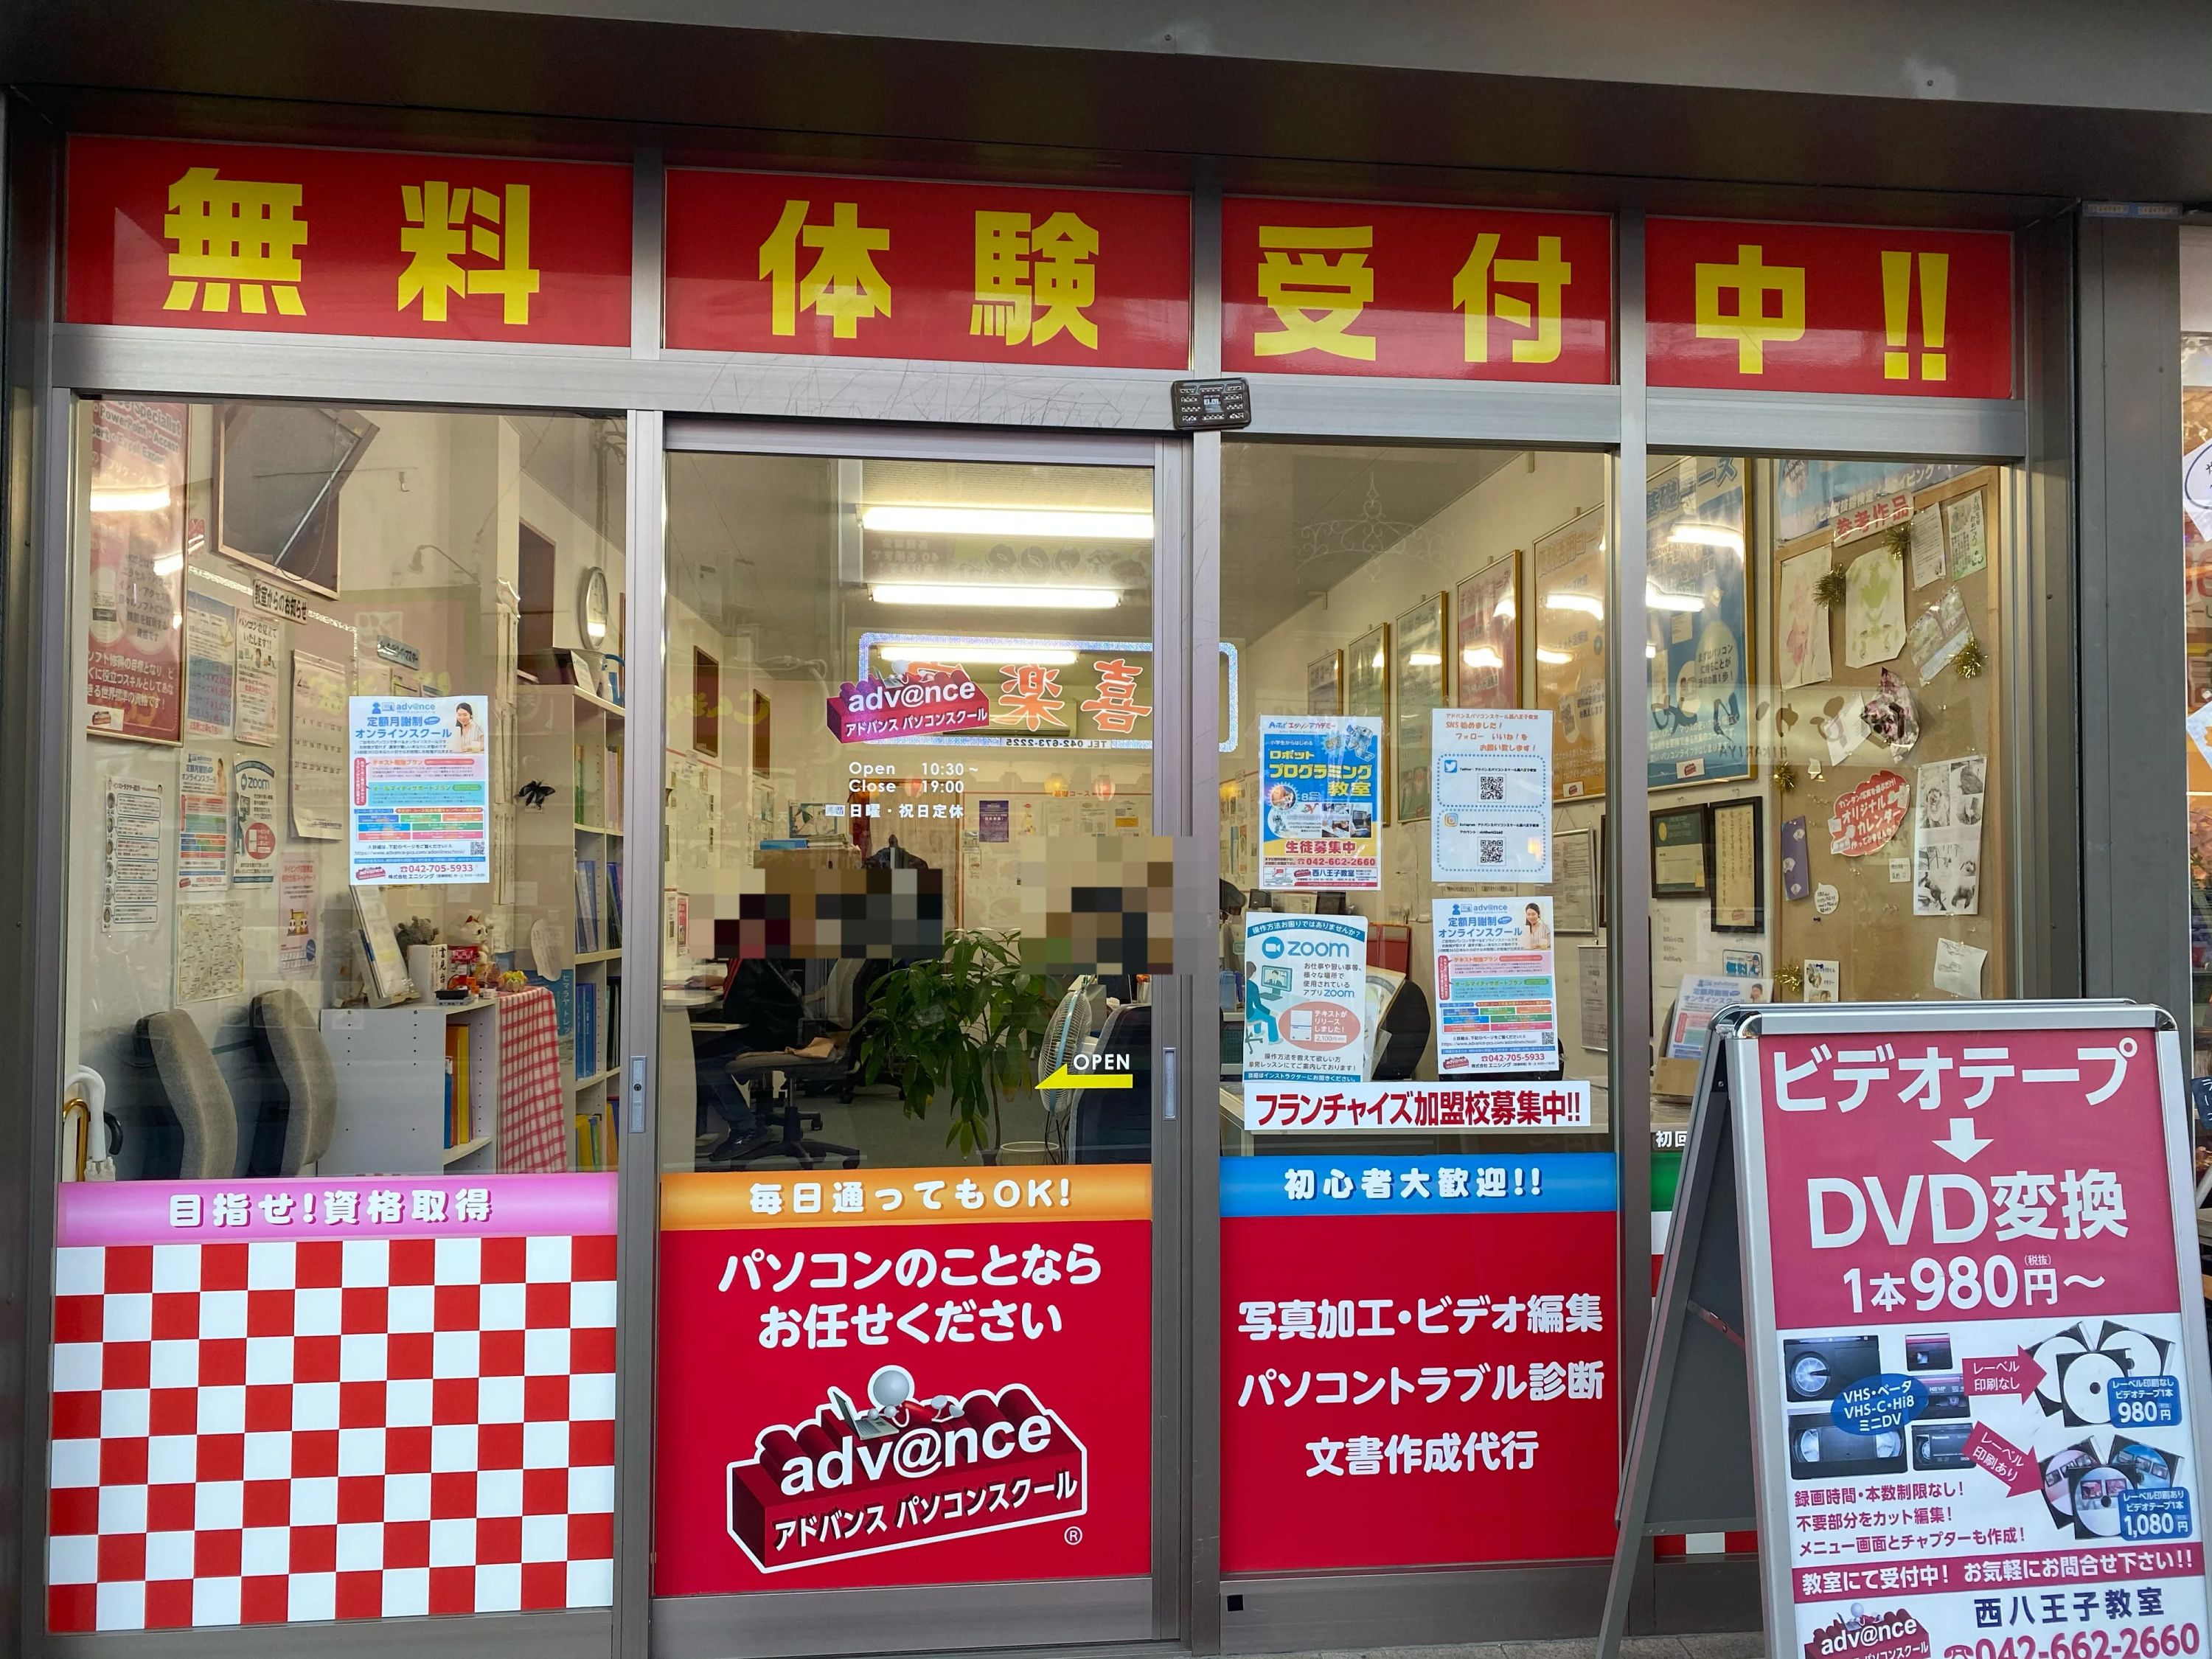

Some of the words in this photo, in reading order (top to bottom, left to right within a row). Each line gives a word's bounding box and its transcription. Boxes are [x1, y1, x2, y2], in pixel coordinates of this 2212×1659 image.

[162, 167, 540, 326] 無料
[758, 199, 1100, 352] 体験
[1253, 225, 1572, 365] 受付
[100, 406, 147, 436] PowerPoint
[134, 402, 182, 436] Specialist
[1836, 494, 1910, 540] 参考作品
[254, 583, 307, 621] 教室からのお知らせ
[848, 681, 975, 712] adv@nce
[355, 728, 452, 739] オンラインスクール
[367, 717, 422, 727] 定額月謝制
[846, 719, 899, 737] アドバンス
[902, 708, 988, 731] パソコンスクール
[1269, 749, 1315, 760] ロボット
[849, 761, 895, 777] Open
[922, 762, 964, 775] 10:30
[1269, 763, 1372, 779] プログラミング
[248, 776, 270, 791] zoom
[849, 779, 897, 793] Close
[922, 780, 964, 793] 19:00
[1328, 782, 1372, 797] 教室
[850, 803, 964, 818] 日曜・祝日定休
[1842, 795, 1886, 824] オリジナル
[1857, 808, 1901, 835] カレンダー
[1285, 840, 1357, 855] 生徒募集中
[408, 864, 473, 872] 042-705-5933
[1312, 869, 1354, 877] 西八王子教室
[1439, 927, 1523, 938] オンラインスクール
[1448, 916, 1497, 928] 定額月謝制
[1287, 941, 1349, 958] zoom
[439, 947, 447, 983] 書見台
[1304, 962, 1361, 971] お仕事や習い事等、
[1304, 971, 1345, 979] 様々な場所で
[562, 975, 570, 1006] ヒマラヤ
[1303, 980, 1350, 988] 使用されている
[1324, 989, 1354, 998] zoom
[1073, 1053, 1131, 1071] OPEN
[1265, 1053, 1341, 1062] 操作方法を教えて欲しい方
[1489, 1054, 1545, 1062] 042-705-5933
[1773, 1037, 2138, 1113] ビデオテープ
[1255, 1091, 1582, 1127] フランチャイズ加盟校募集中!!
[1284, 1166, 1544, 1200] 初心者大歓迎!!
[169, 1188, 493, 1229] 目指せ!資格取得
[749, 1178, 1073, 1215] 毎日通ってもOK!
[1807, 1168, 2129, 1249] DVD変換
[718, 1242, 1102, 1293] パソコンのことなら
[2023, 1254, 2052, 1267] (税抜)
[758, 1298, 1063, 1350] お任せください
[1238, 1293, 1604, 1340] 写真加工・ビデオ編集
[1973, 1362, 2020, 1375] レーベル
[1238, 1360, 1605, 1408] パソコントラブル診断
[1843, 1380, 1913, 1405] VHS・ベータ
[1974, 1376, 2020, 1392] 印刷なし
[2112, 1378, 2174, 1388] レーベル印刷なし
[2115, 1389, 2174, 1399] ビデオテープ1本
[1844, 1395, 1915, 1419] VHS-C・Hi8
[2118, 1401, 2171, 1423] 980円
[1860, 1413, 1902, 1432] ミニDV
[780, 1413, 1052, 1496] adv@nce
[1306, 1430, 1539, 1478] 文書作成代行
[1980, 1432, 2025, 1467] レーベル
[1972, 1447, 2019, 1482] 印刷あり
[1794, 1481, 1965, 1507] 録画時間・本数制限なし!
[2124, 1489, 2184, 1502] レーベル印刷あり
[2126, 1501, 2184, 1512] ビデオテープ1本
[774, 1506, 886, 1551] アドバンス
[897, 1470, 1078, 1528] パソコンスクール
[1796, 1506, 1952, 1533] 不要部分をカット編集!
[2124, 1513, 2188, 1539] 1,080円
[1799, 1527, 2026, 1556] メニュー画面とチャプターも作成!
[1801, 1563, 1950, 1596] 教室にて受付中!
[1964, 1548, 2193, 1584] お気軽にお問合せ下さい!!
[1974, 1587, 2165, 1629] 西八王子教室
[1821, 1618, 1917, 1656] adv@nce
[1975, 1622, 2201, 1659] 042-662-2660
